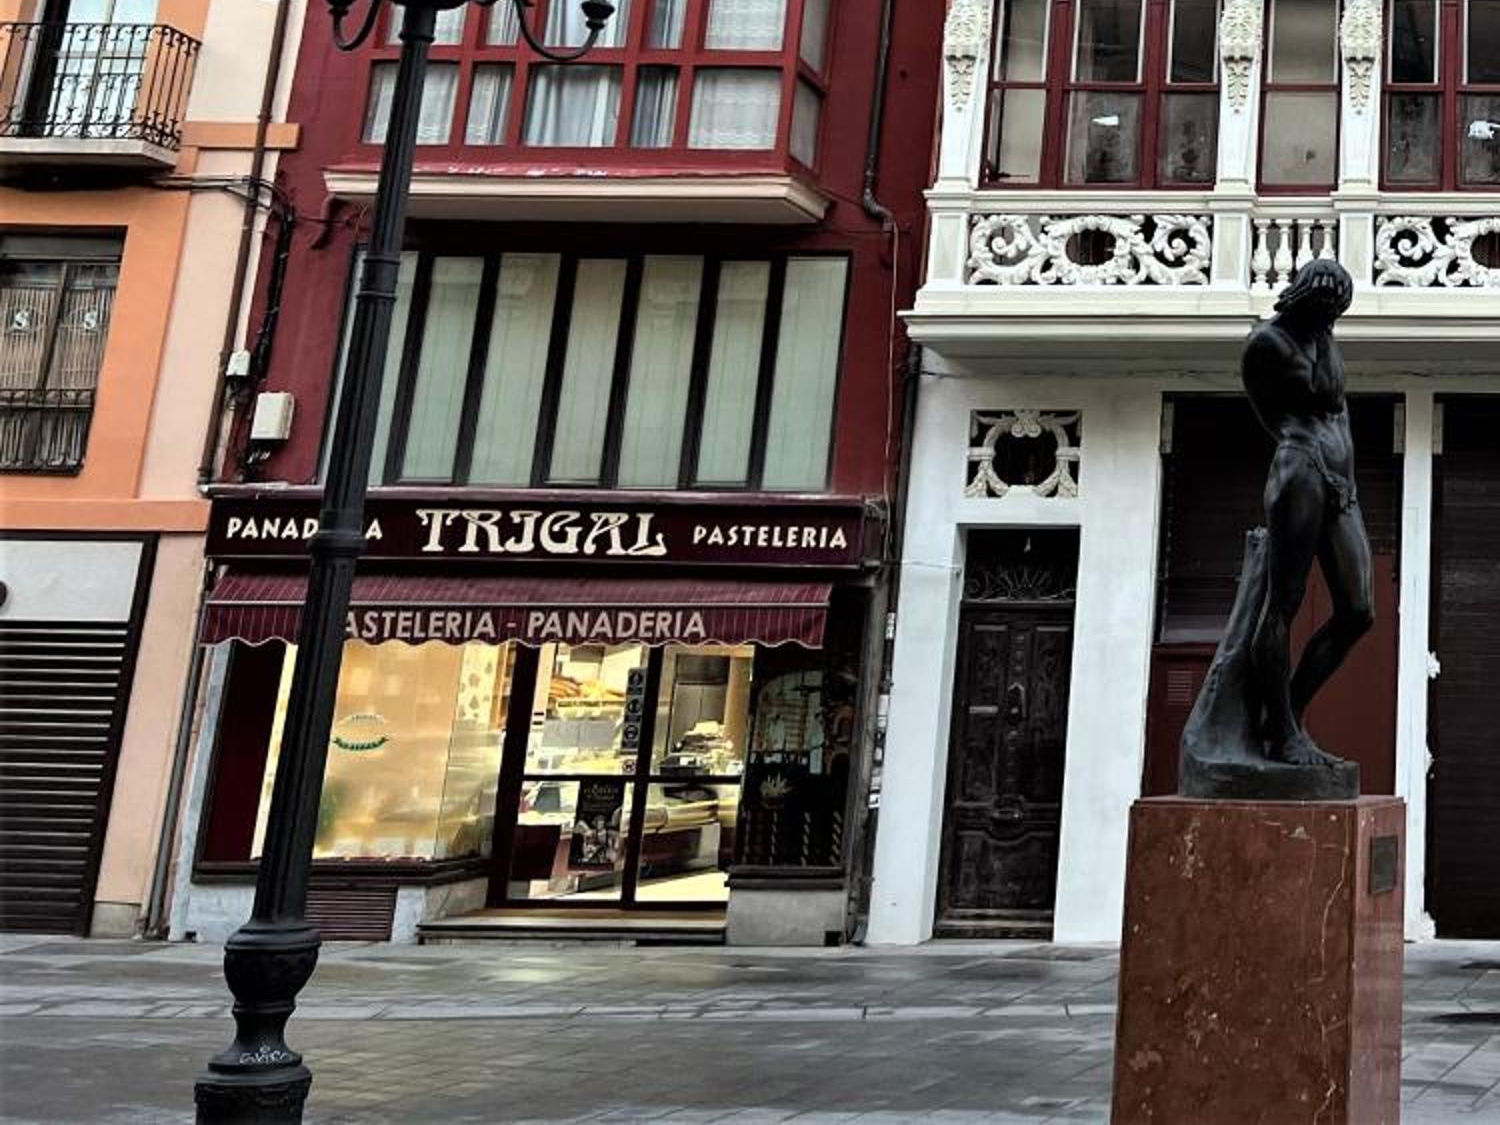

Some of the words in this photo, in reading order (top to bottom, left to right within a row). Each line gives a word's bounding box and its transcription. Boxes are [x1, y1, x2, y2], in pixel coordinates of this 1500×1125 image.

[226, 517, 383, 540] PANADA
[416, 508, 667, 556] TRIGAL
[692, 525, 848, 549] PASTELERIA
[345, 611, 496, 639] ASTELERIA
[527, 611, 707, 639] PANADERIA
